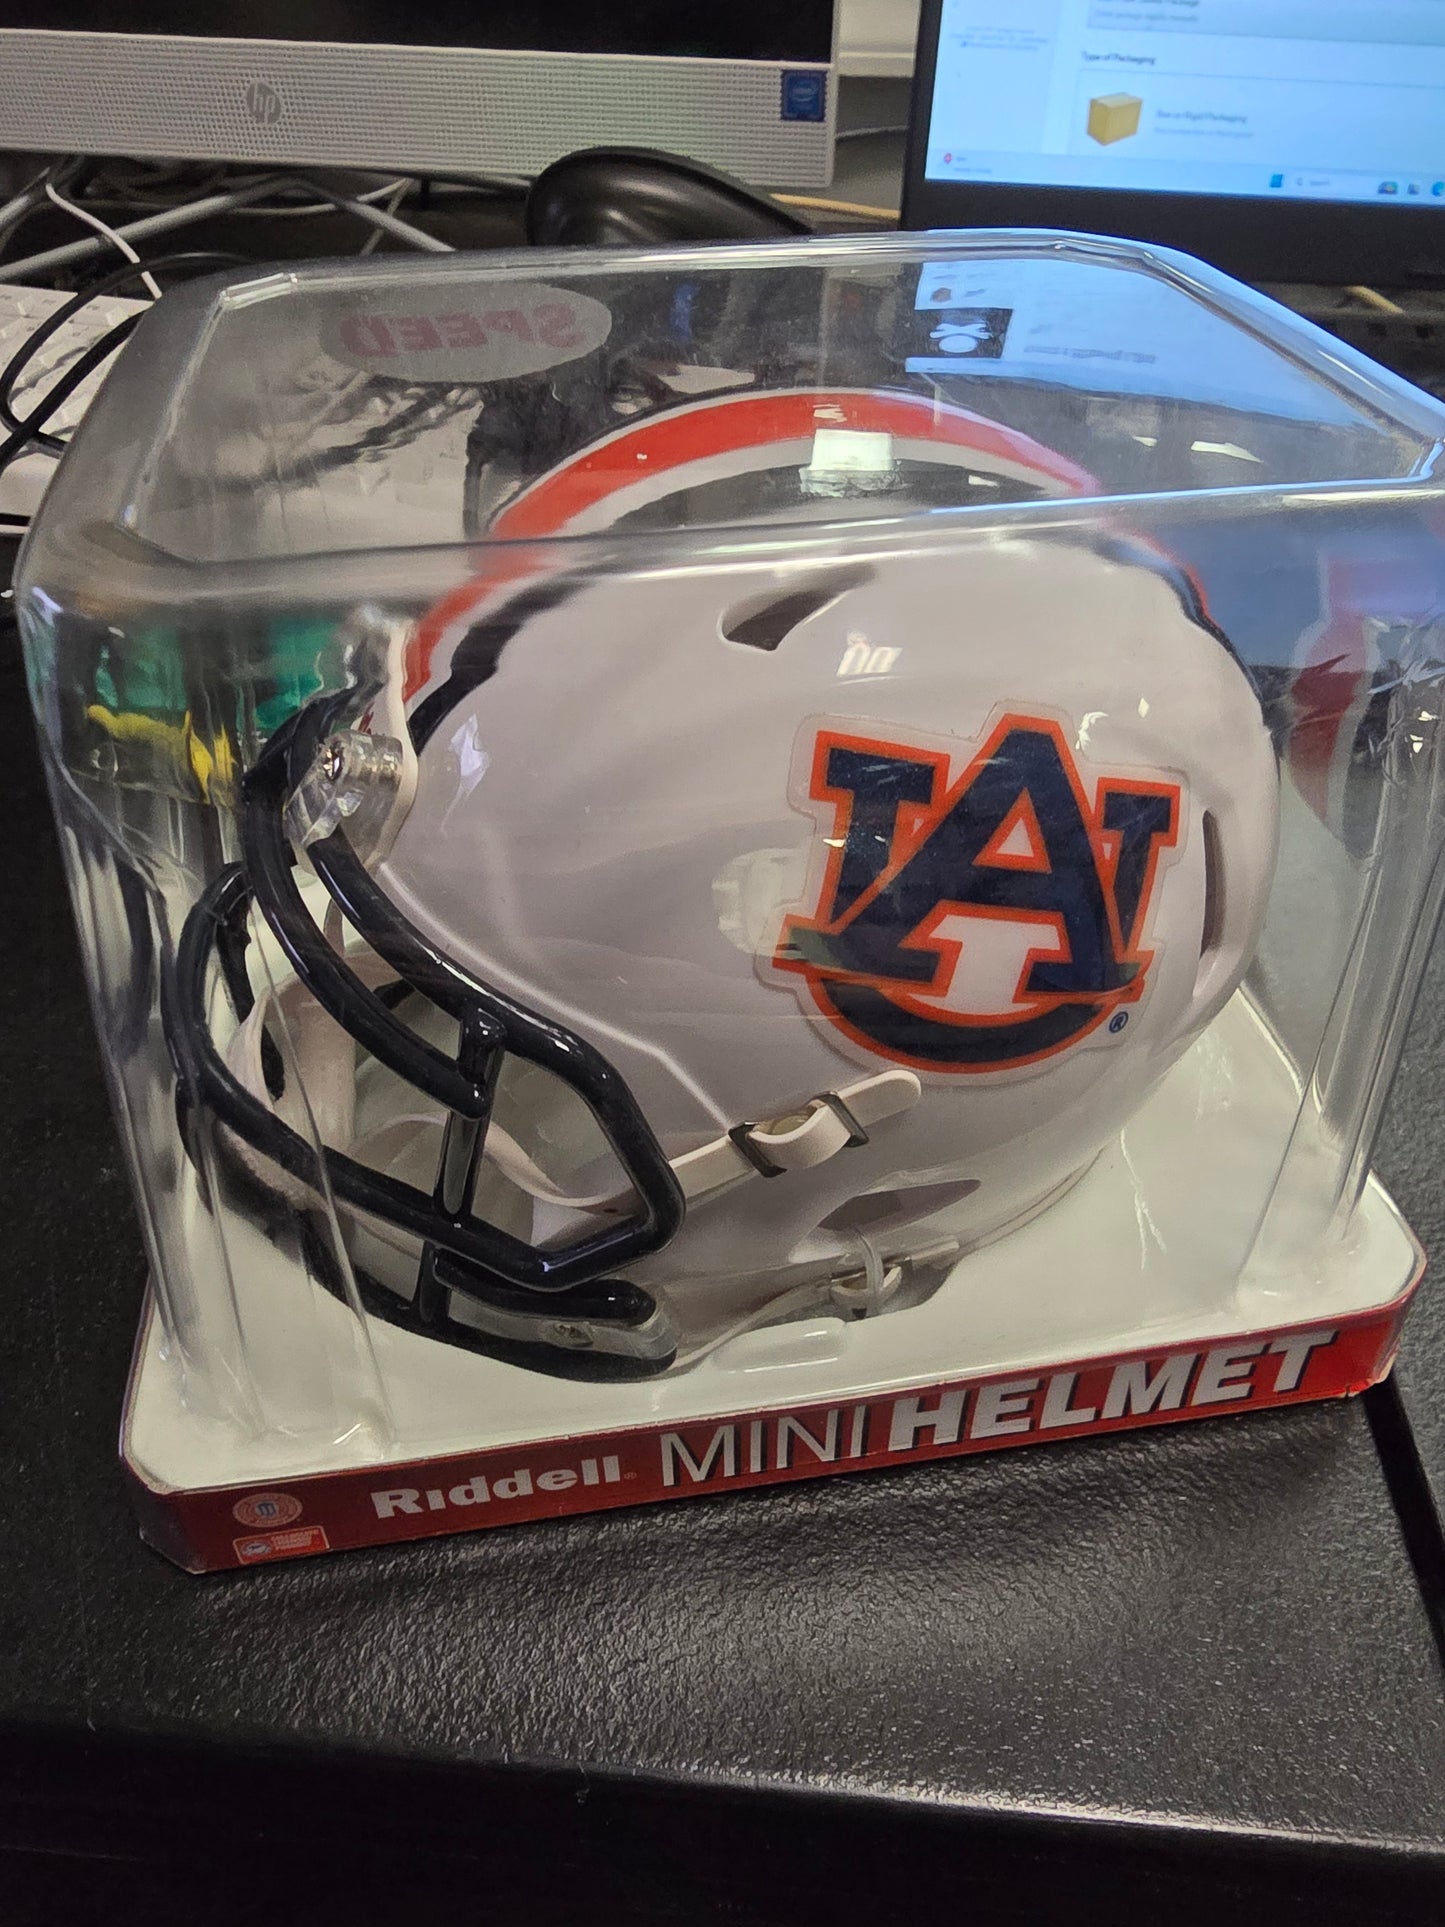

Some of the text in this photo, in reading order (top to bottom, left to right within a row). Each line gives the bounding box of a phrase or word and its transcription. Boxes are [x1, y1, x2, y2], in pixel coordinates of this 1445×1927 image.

[370, 1329, 1338, 1520] Riddell MINI HELMET
